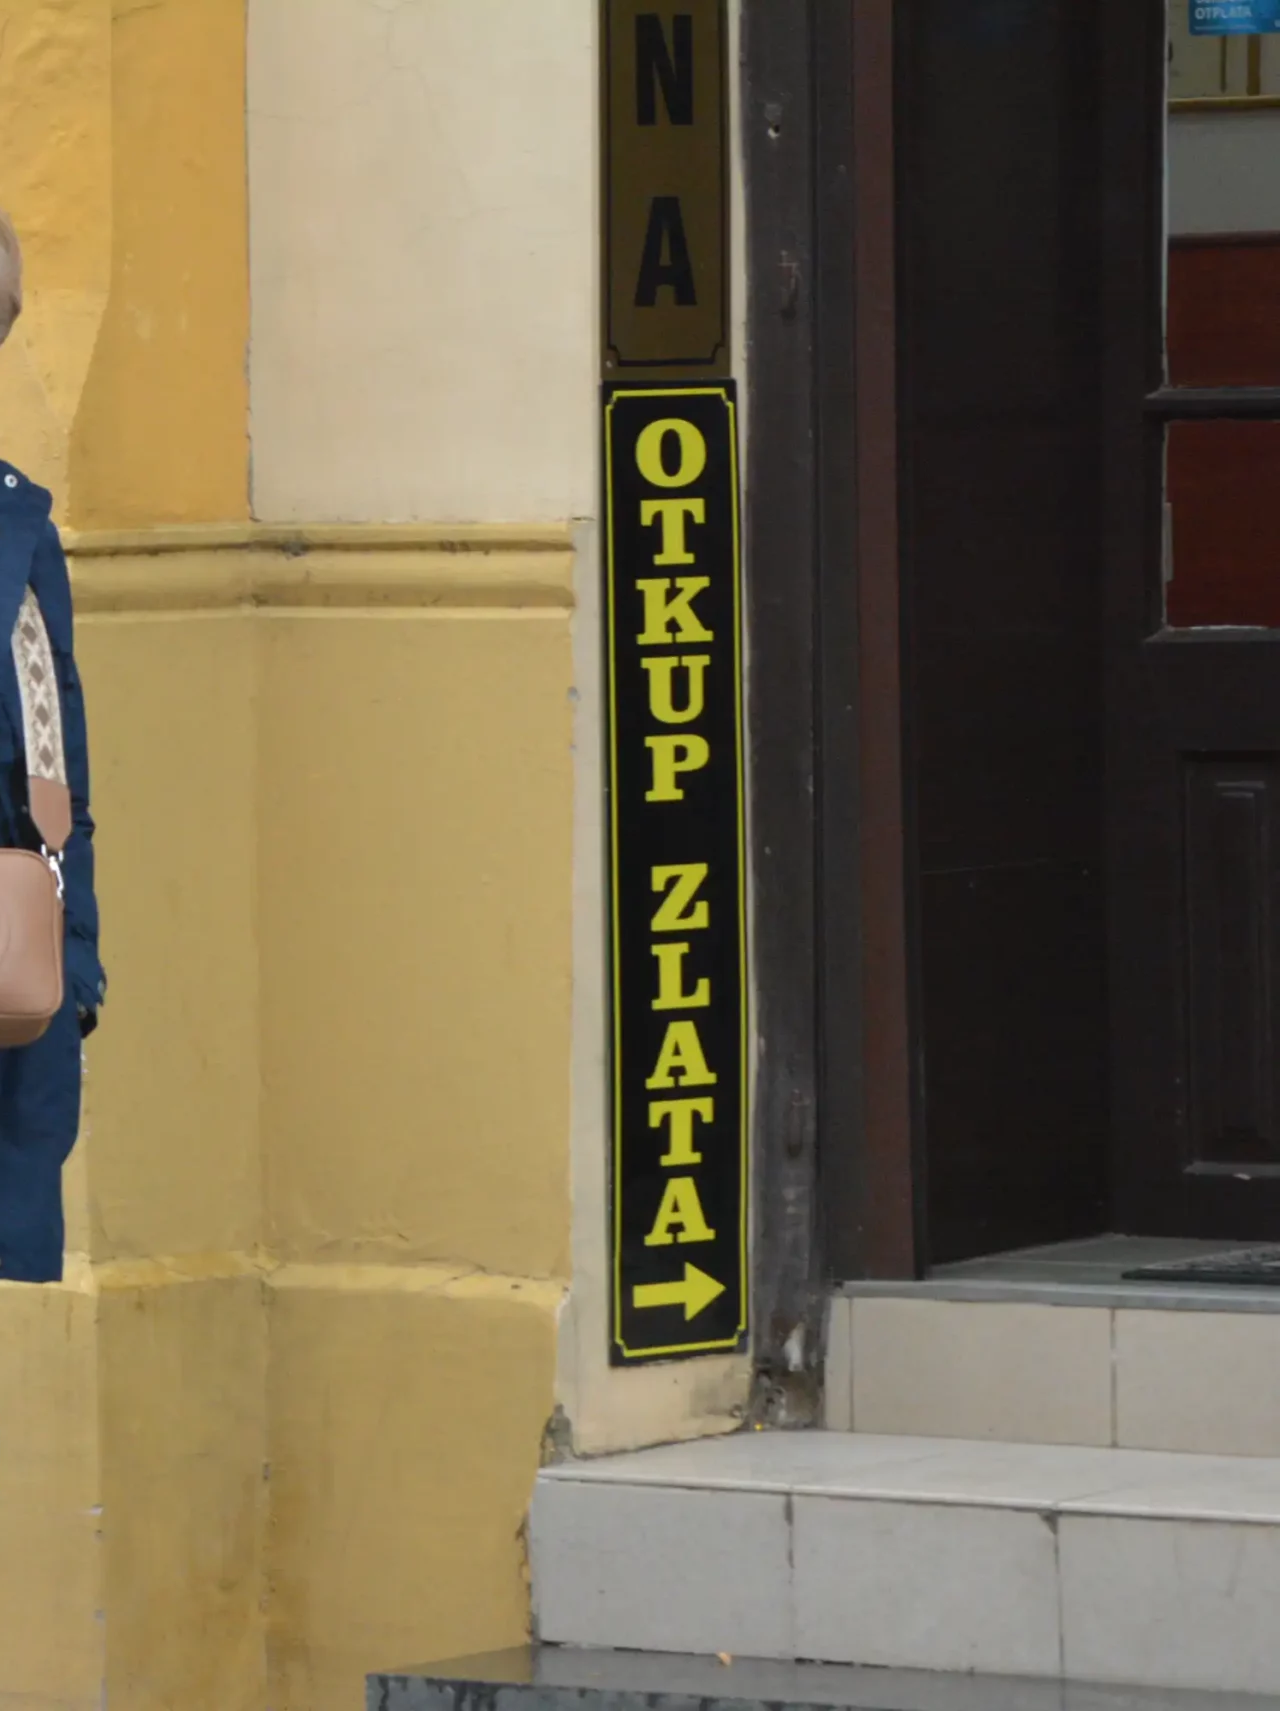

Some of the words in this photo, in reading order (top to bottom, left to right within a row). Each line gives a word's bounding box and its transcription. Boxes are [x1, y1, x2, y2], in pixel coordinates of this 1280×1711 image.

[1194, 6, 1253, 20] OTPLATA
[635, 418, 714, 802] OTKUP
[644, 863, 717, 1246] ZLATA
